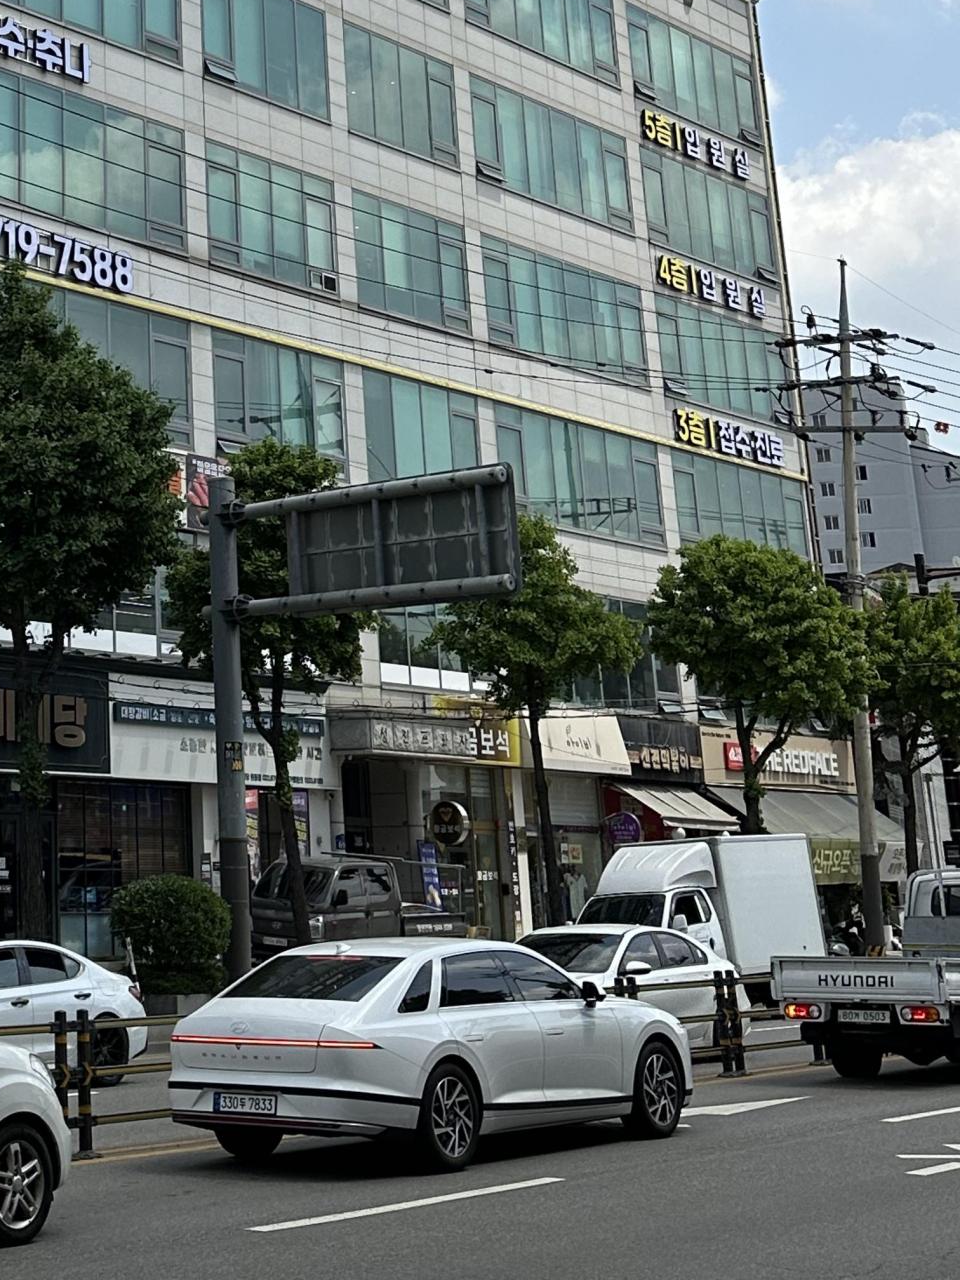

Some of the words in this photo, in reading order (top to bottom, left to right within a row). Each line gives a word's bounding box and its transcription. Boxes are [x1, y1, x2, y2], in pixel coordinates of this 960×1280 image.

[643, 109, 673, 149] 5층
[658, 254, 689, 292] 4층
[675, 408, 708, 448] 3층
[641, 746, 690, 774] 신전떡볶이
[783, 750, 840, 777] REDFACE
[817, 974, 895, 988] HYUNDAI
[221, 1095, 246, 1110] 330두
[248, 1097, 273, 1112] 7833
